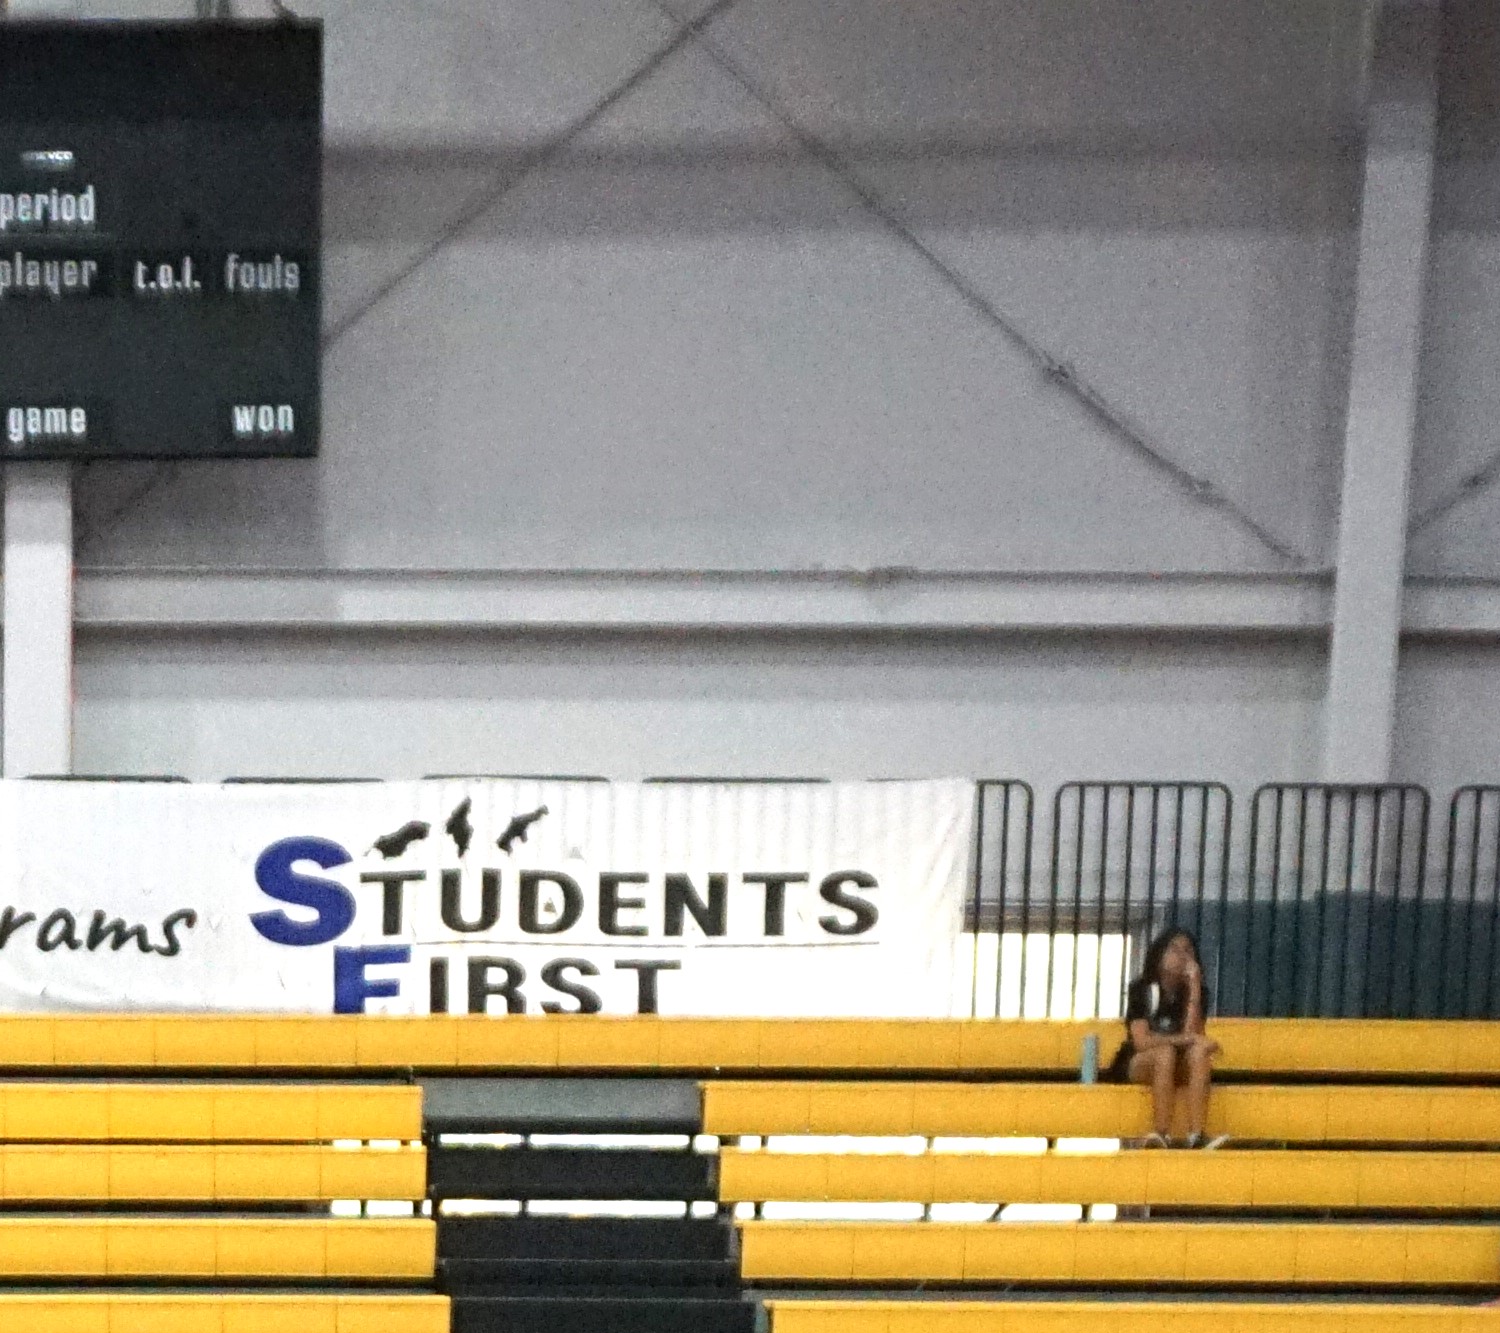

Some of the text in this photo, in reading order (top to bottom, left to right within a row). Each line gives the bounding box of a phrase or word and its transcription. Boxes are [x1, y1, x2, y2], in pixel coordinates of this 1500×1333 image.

[134, 255, 201, 291] t.o.l.
[225, 253, 300, 292] fouls
[8, 406, 87, 442] game
[232, 404, 294, 433] won
[248, 835, 880, 947] STUDENTS
[333, 944, 682, 1015] FIRST
